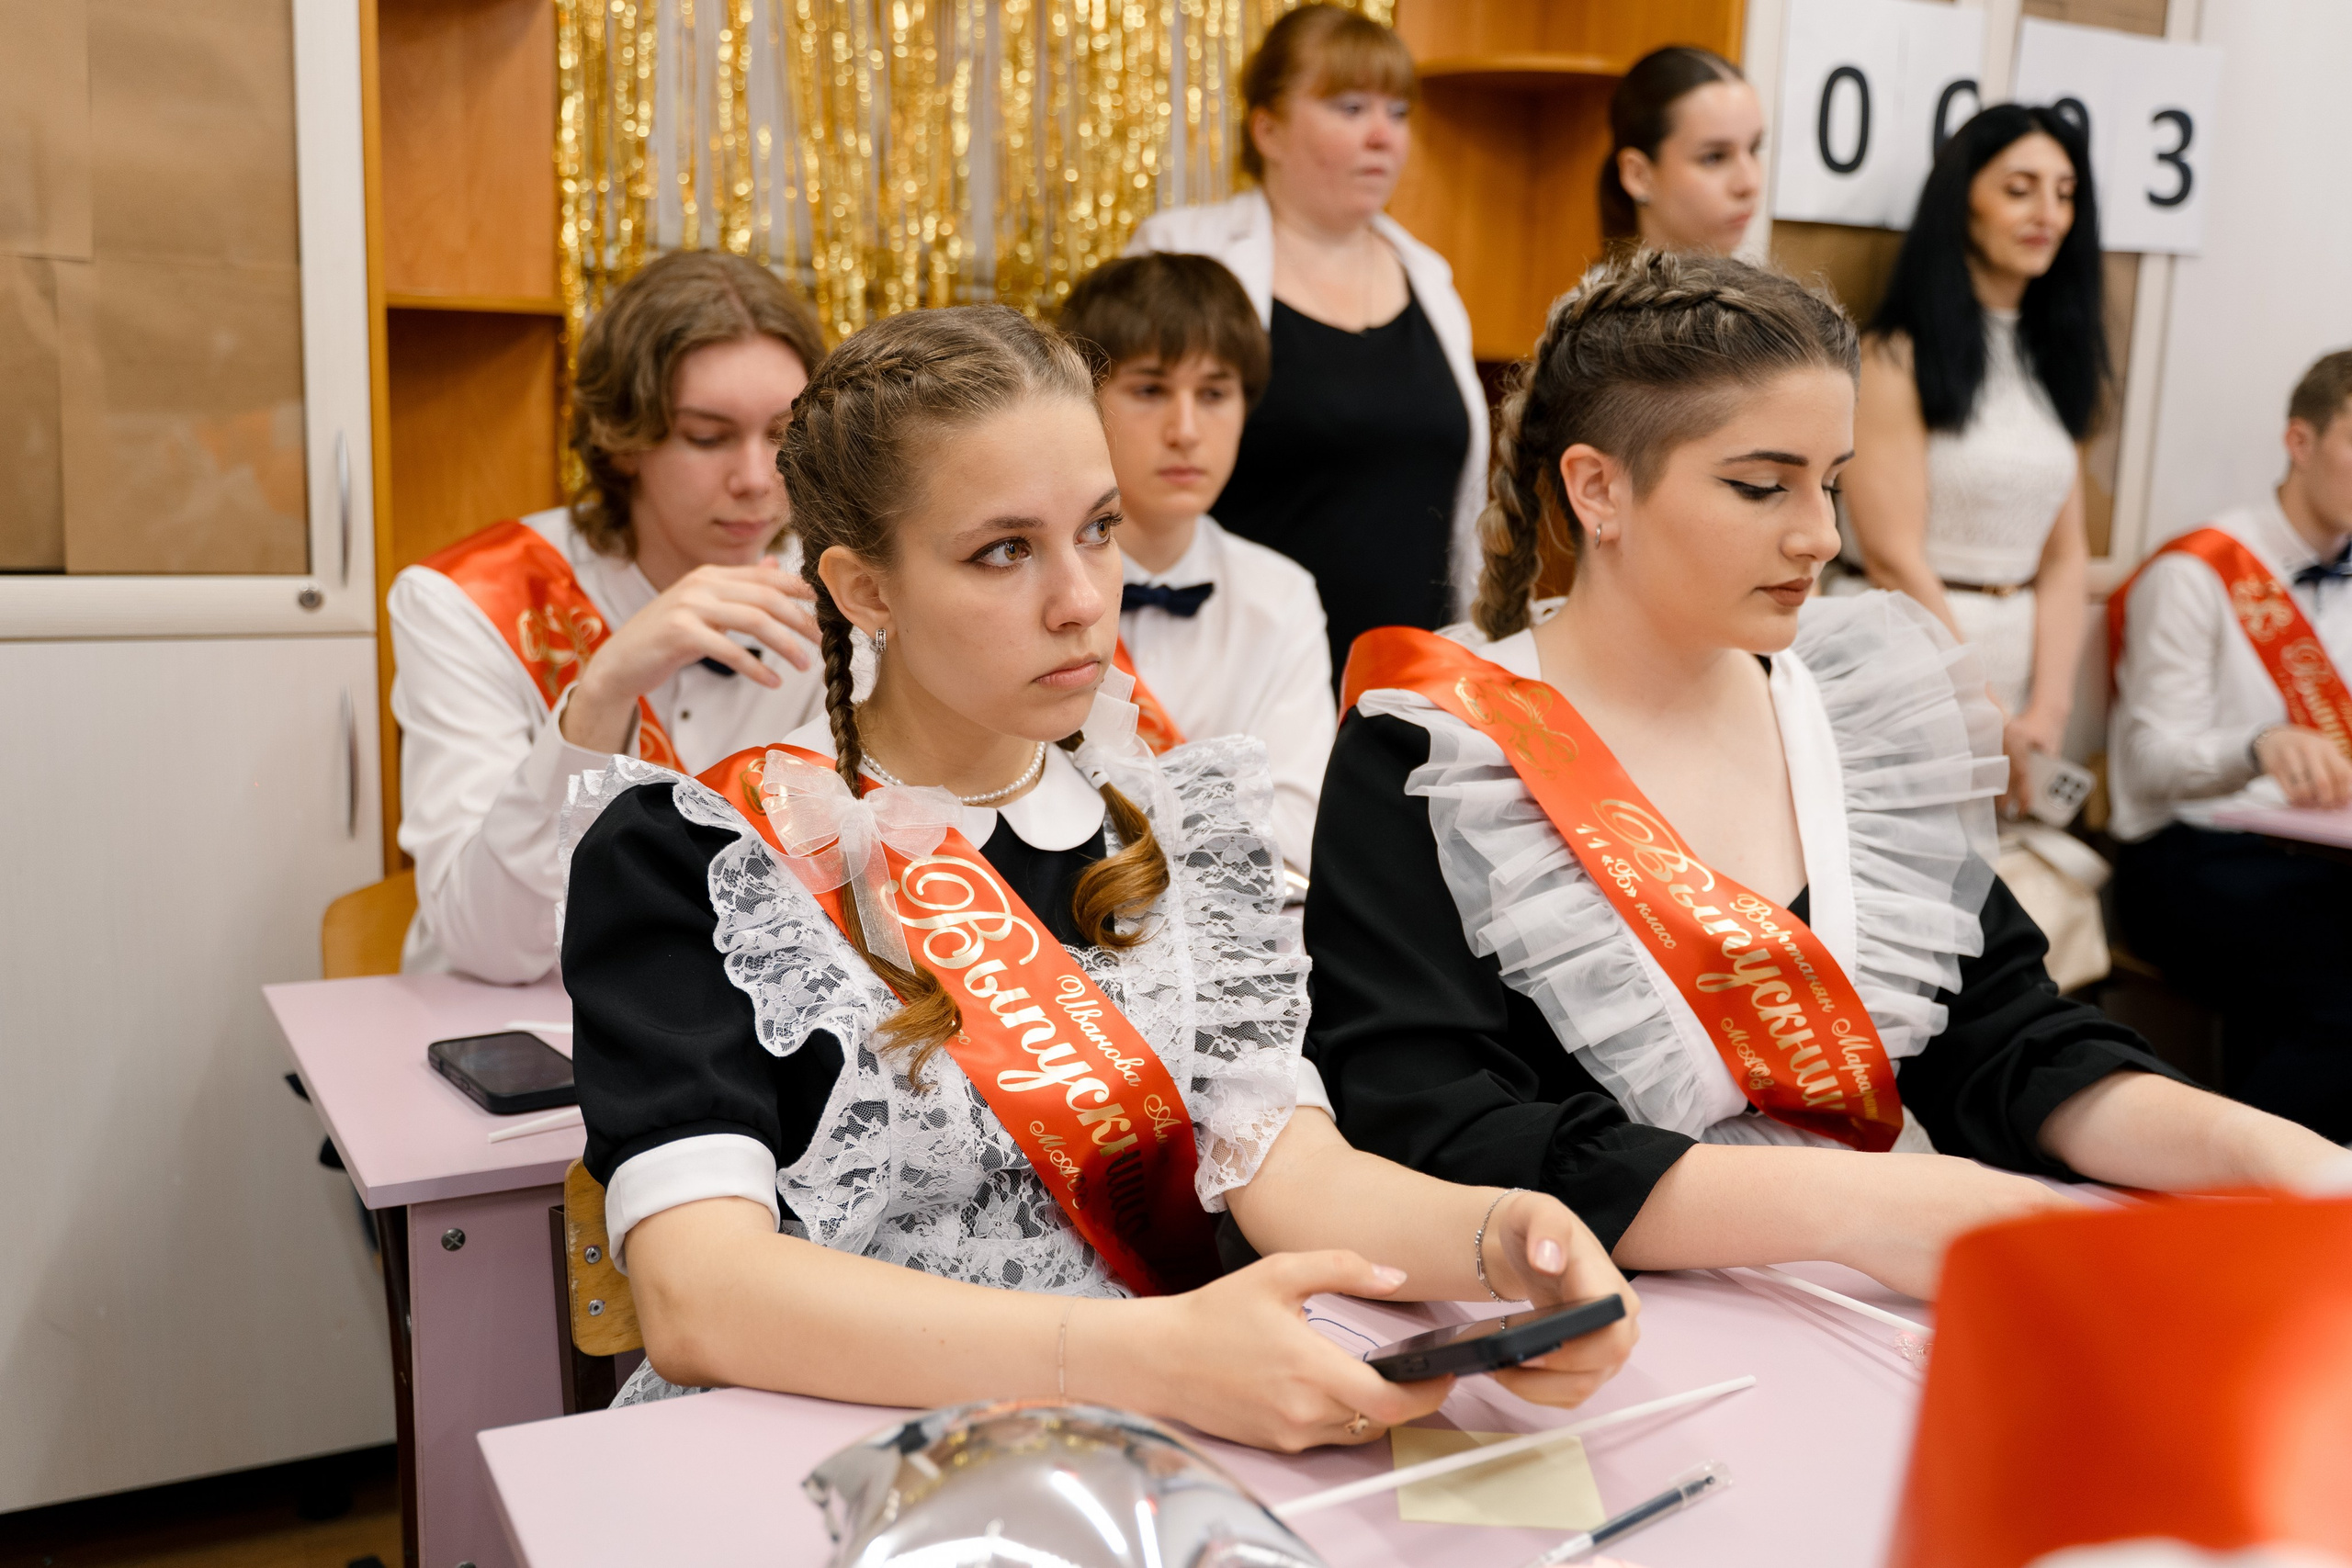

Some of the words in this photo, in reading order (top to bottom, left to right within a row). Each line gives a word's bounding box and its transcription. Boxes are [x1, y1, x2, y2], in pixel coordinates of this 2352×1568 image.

[1816, 65, 1872, 175] 0
[2147, 108, 2196, 208] 3
[1634, 902, 1678, 950] класс
[1728, 893, 1836, 1013] Вартанян
[1056, 974, 1146, 1088] Иванова
